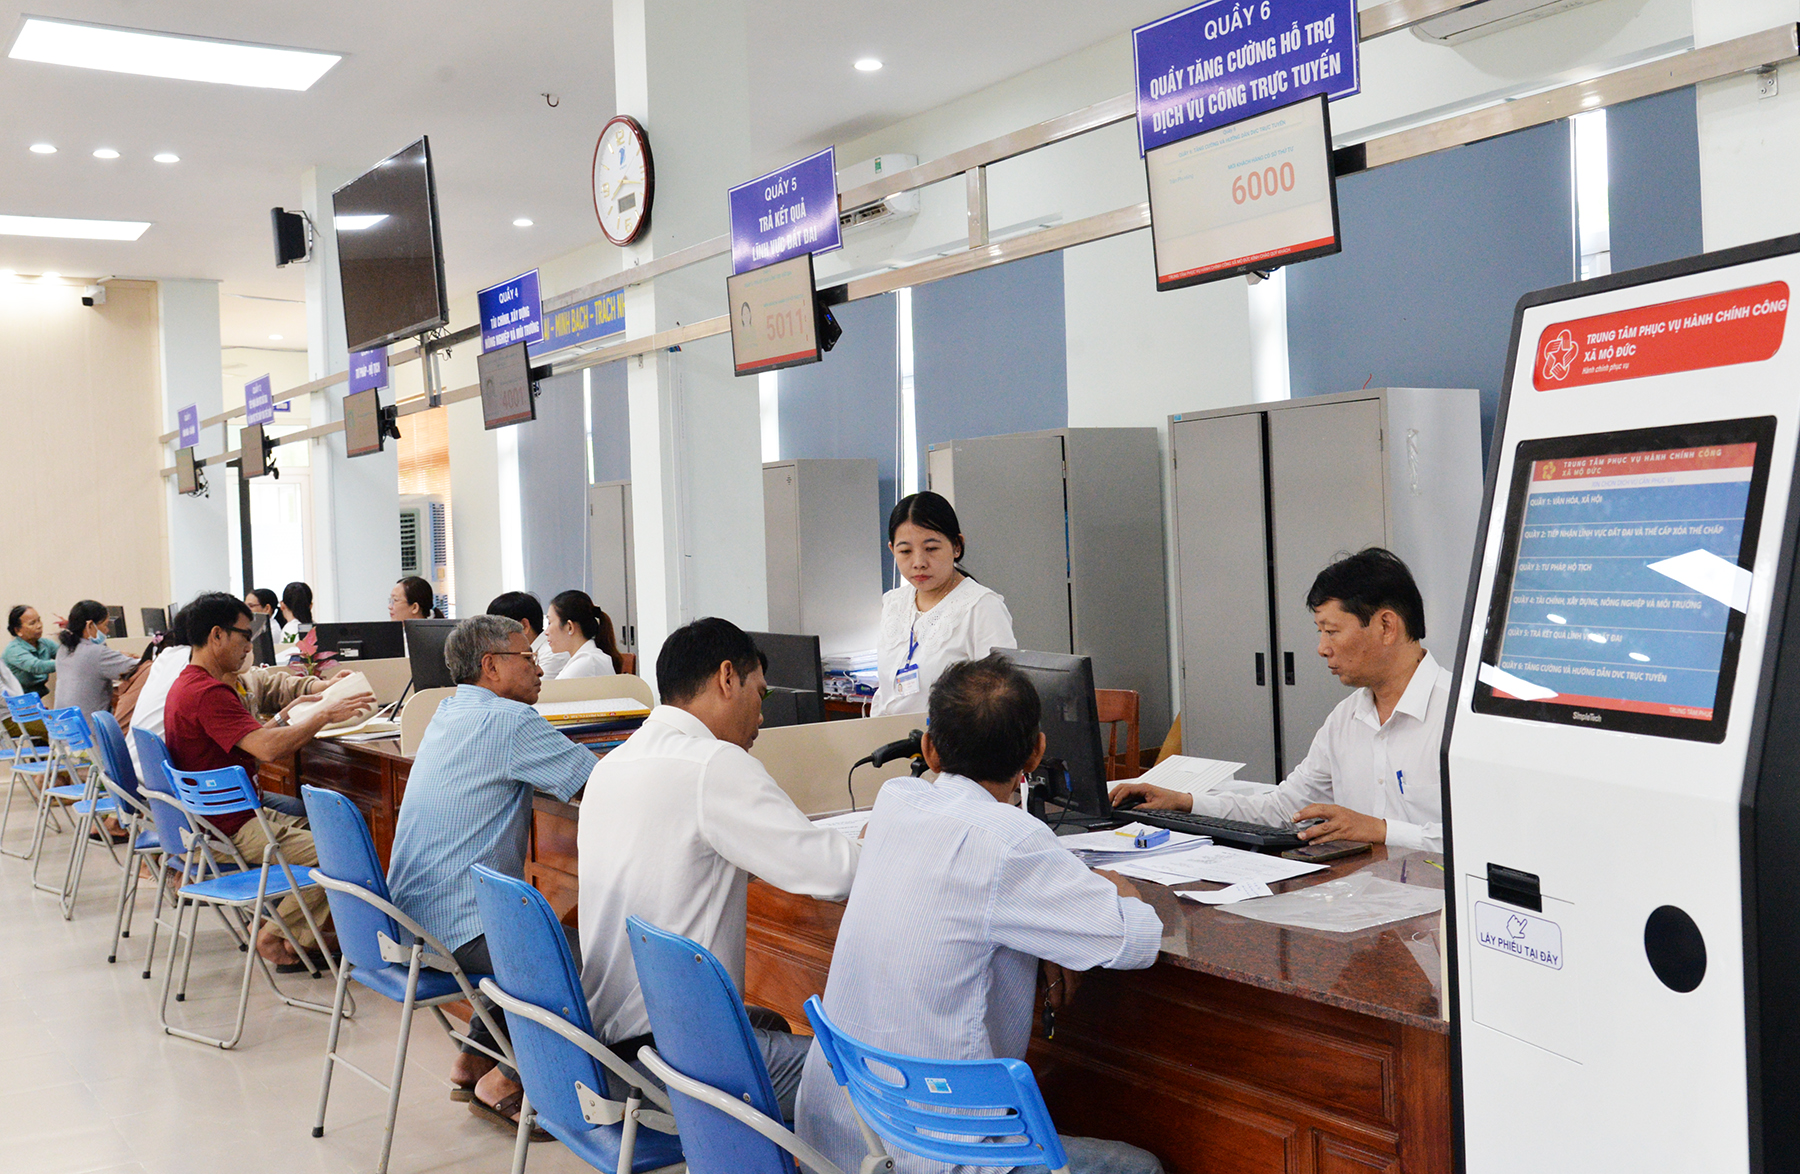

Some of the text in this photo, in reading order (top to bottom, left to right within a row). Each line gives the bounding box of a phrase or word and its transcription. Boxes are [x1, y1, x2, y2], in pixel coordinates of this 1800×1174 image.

[1204, 0, 1271, 40] QUẦY 6
[1150, 14, 1335, 99] QUẦY TĂNG CƯỜNG HỖ TRỢ
[1152, 49, 1341, 134] DỊCH VỤ CÔNG TRỰC TUYẾN
[764, 177, 797, 201] QUẦY 5
[1232, 162, 1295, 205] 6000
[759, 197, 806, 233] TRẢ KẾT QUẢ
[752, 226, 818, 261] LĨNH VỰC ĐẤT ĐAI
[515, 287, 518, 298] 4
[555, 310, 570, 337] MINH
[571, 305, 589, 336] BẠCH
[594, 295, 616, 325] TRÁCH
[766, 308, 803, 341] 5011
[1587, 298, 1787, 344] TRUNG TÂM PHỤC VỤ HÀNH CHÍNH CÔNG
[1583, 342, 1636, 362] XÃ MỘ ĐỨC
[1607, 456, 1627, 465] PHỤC
[1644, 453, 1666, 461] HÀNH
[1670, 450, 1695, 460] CHÍNH
[1698, 448, 1722, 457] CÔNG
[1574, 468, 1584, 476] MỘ
[1586, 466, 1602, 474] ĐỨC
[1580, 494, 1590, 504] XÃ
[1591, 494, 1603, 504] HỘI
[1524, 530, 1540, 539] QUẦY
[1547, 528, 1559, 537] TIẾP
[1560, 528, 1577, 539] NHẬN
[1594, 527, 1607, 538] VỰC
[1608, 526, 1621, 536] ĐẤT
[1621, 528, 1633, 536] ĐAI
[1634, 526, 1643, 536] VÀ
[1672, 525, 1687, 535] XÓA
[1704, 524, 1724, 534] CHẤP
[1519, 562, 1534, 571] QUẦY
[1567, 562, 1577, 572] HỘ
[1578, 563, 1593, 572] TỊCH
[1513, 595, 1529, 604] QUẦY
[1567, 596, 1579, 605] XÂY
[1621, 598, 1645, 609] NGHIỆP
[1646, 598, 1655, 608] VÀ
[1656, 598, 1670, 608] MÔI
[1507, 628, 1523, 637] QUẦY
[1610, 634, 1623, 642] ĐAI
[1502, 661, 1518, 669] QUẦY
[1524, 662, 1539, 672] TĂNG
[1540, 664, 1562, 673] CƯỜNG
[1563, 665, 1570, 674] VÀ
[1572, 666, 1595, 676] HƯỚNG
[1596, 667, 1610, 677] DẪN
[1612, 671, 1624, 679] DVC
[1626, 672, 1644, 682] TRỰC
[1645, 672, 1667, 682] TUYẾN
[1573, 711, 1602, 722] SimpleTech
[1481, 932, 1558, 965] LẤY PHIẾU TẠI ĐÂY
